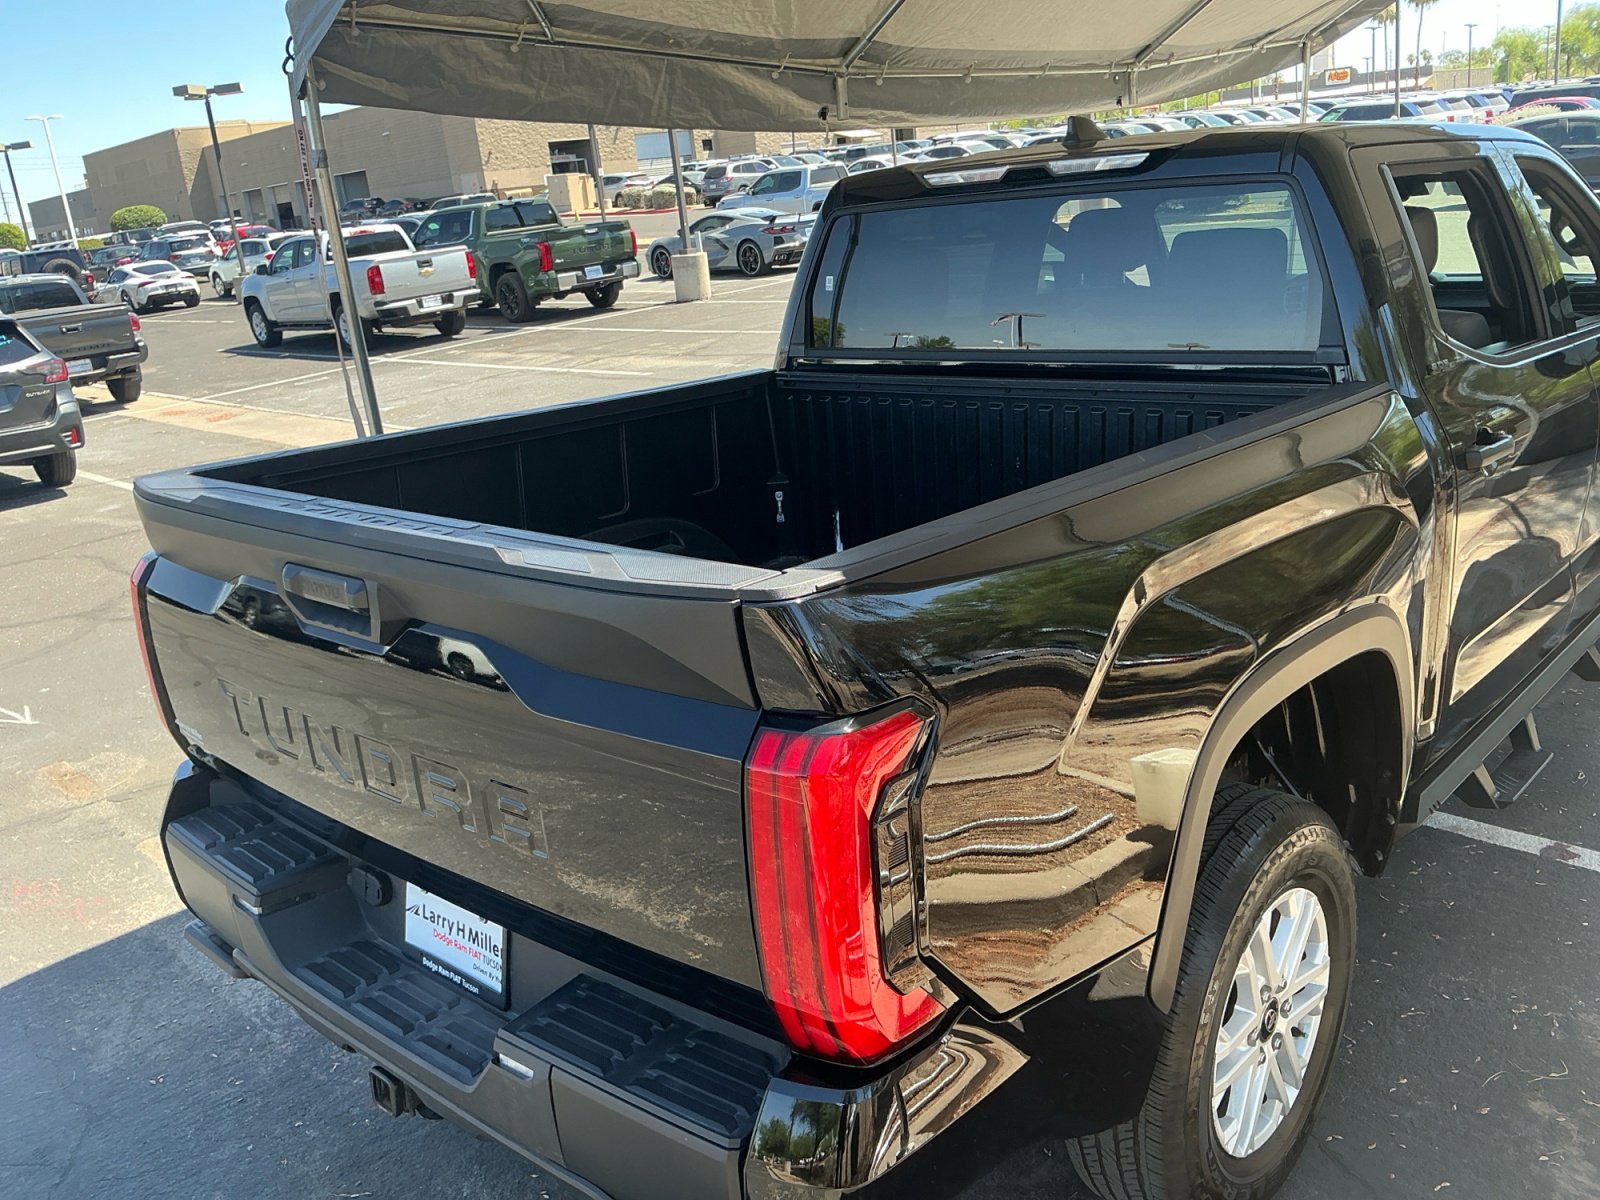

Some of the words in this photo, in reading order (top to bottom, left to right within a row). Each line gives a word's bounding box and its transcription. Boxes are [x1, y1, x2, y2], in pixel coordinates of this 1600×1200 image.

[217, 678, 549, 859] TUNDRA
[422, 904, 454, 936] Larry
[456, 920, 466, 940] H
[432, 928, 454, 947] Dodge
[454, 939, 468, 954] Ram
[468, 947, 482, 961] FIAT
[422, 956, 439, 972] Dodge
[438, 965, 450, 978] Ram
[450, 971, 462, 984] FIAT
[462, 978, 480, 994] Tucson
